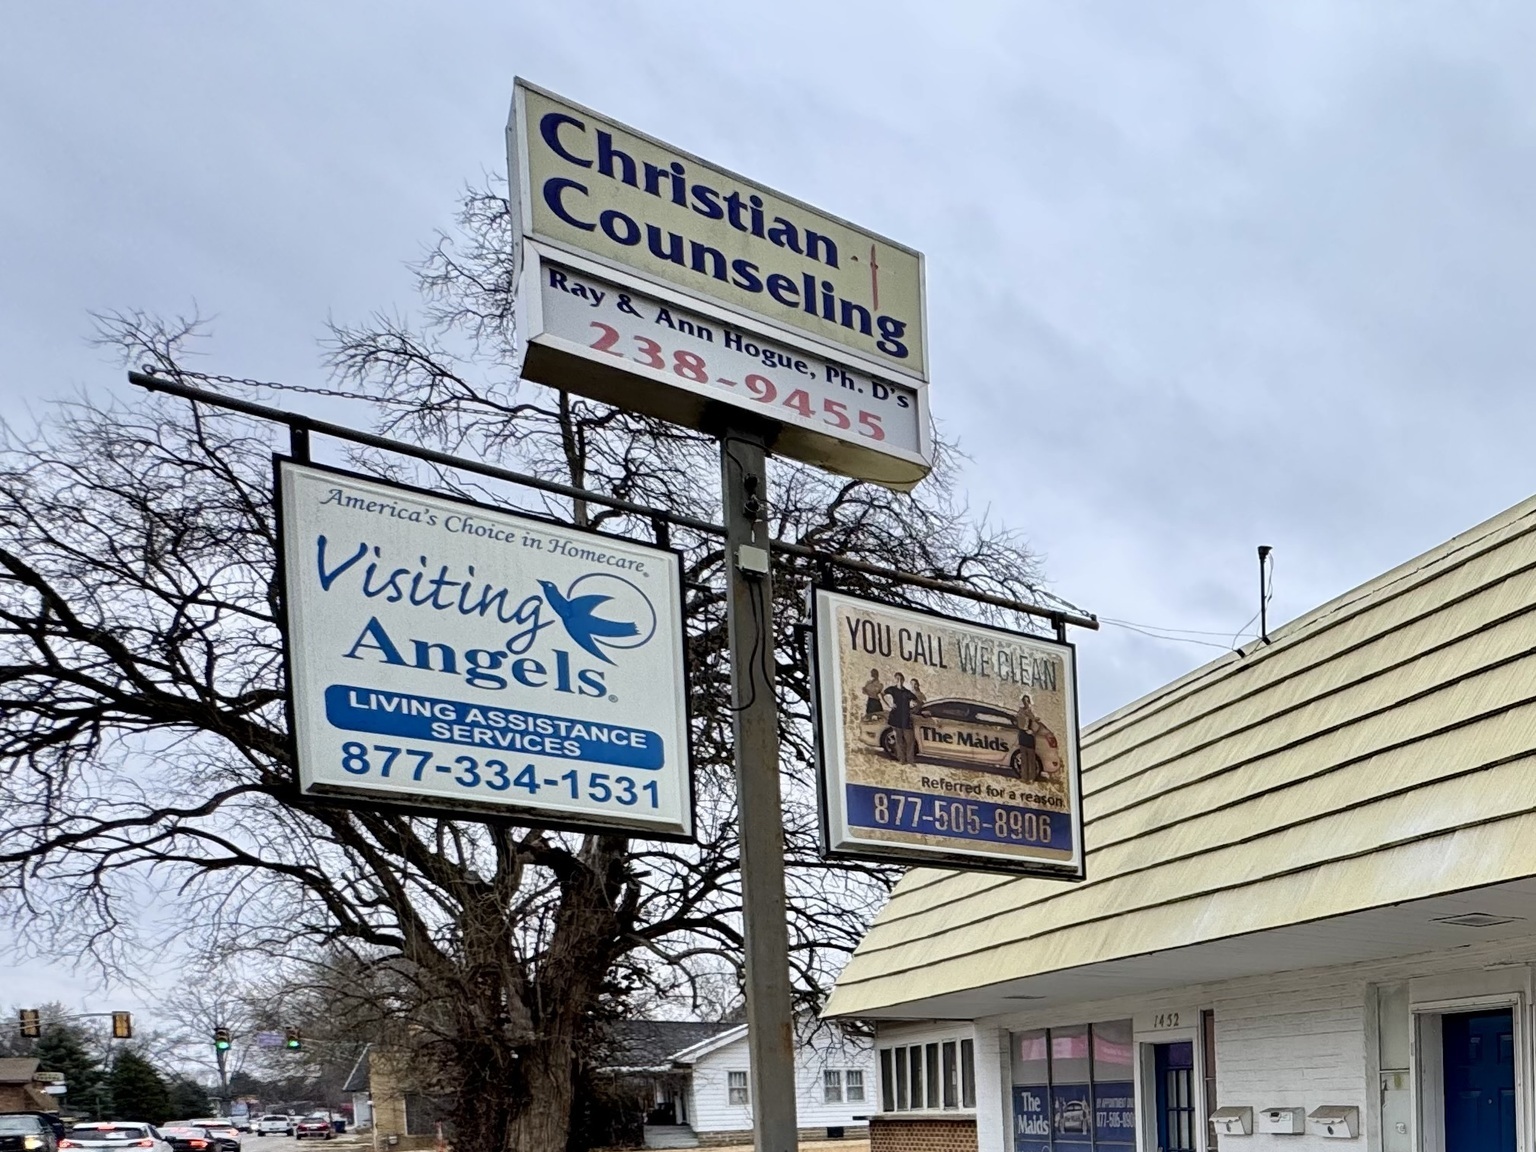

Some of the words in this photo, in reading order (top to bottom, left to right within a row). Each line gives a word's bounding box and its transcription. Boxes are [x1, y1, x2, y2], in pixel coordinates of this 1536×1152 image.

[539, 112, 840, 270] Christian
[543, 177, 909, 359] Counseling
[548, 268, 606, 307] Ray
[616, 293, 645, 319] &
[655, 307, 715, 343] Ann
[724, 329, 817, 380] Hogue,
[825, 367, 865, 394] Ph.
[871, 385, 911, 408] D's
[588, 321, 886, 442] 238-9455
[319, 488, 438, 527] America's
[444, 515, 516, 544] Choice
[520, 531, 544, 551] in
[317, 534, 555, 655] Visiting
[846, 615, 892, 658] YOU
[899, 627, 948, 669] CALL
[956, 639, 991, 678] WE
[997, 650, 1058, 692] CLEAN
[348, 690, 457, 722] LIVING
[465, 707, 648, 749] ASSISTANCE
[430, 722, 582, 757] SERVICES
[920, 726, 953, 745] The
[956, 731, 1010, 753] Maids
[341, 741, 660, 809] 877-334-1531
[921, 776, 981, 794] Referred
[986, 785, 1005, 798] for
[1008, 790, 1016, 800] a
[874, 792, 1051, 843] 877-505-8906
[1154, 1013, 1179, 1028] 1452
[1018, 1114, 1049, 1135] Maids
[1021, 1091, 1041, 1112] The
